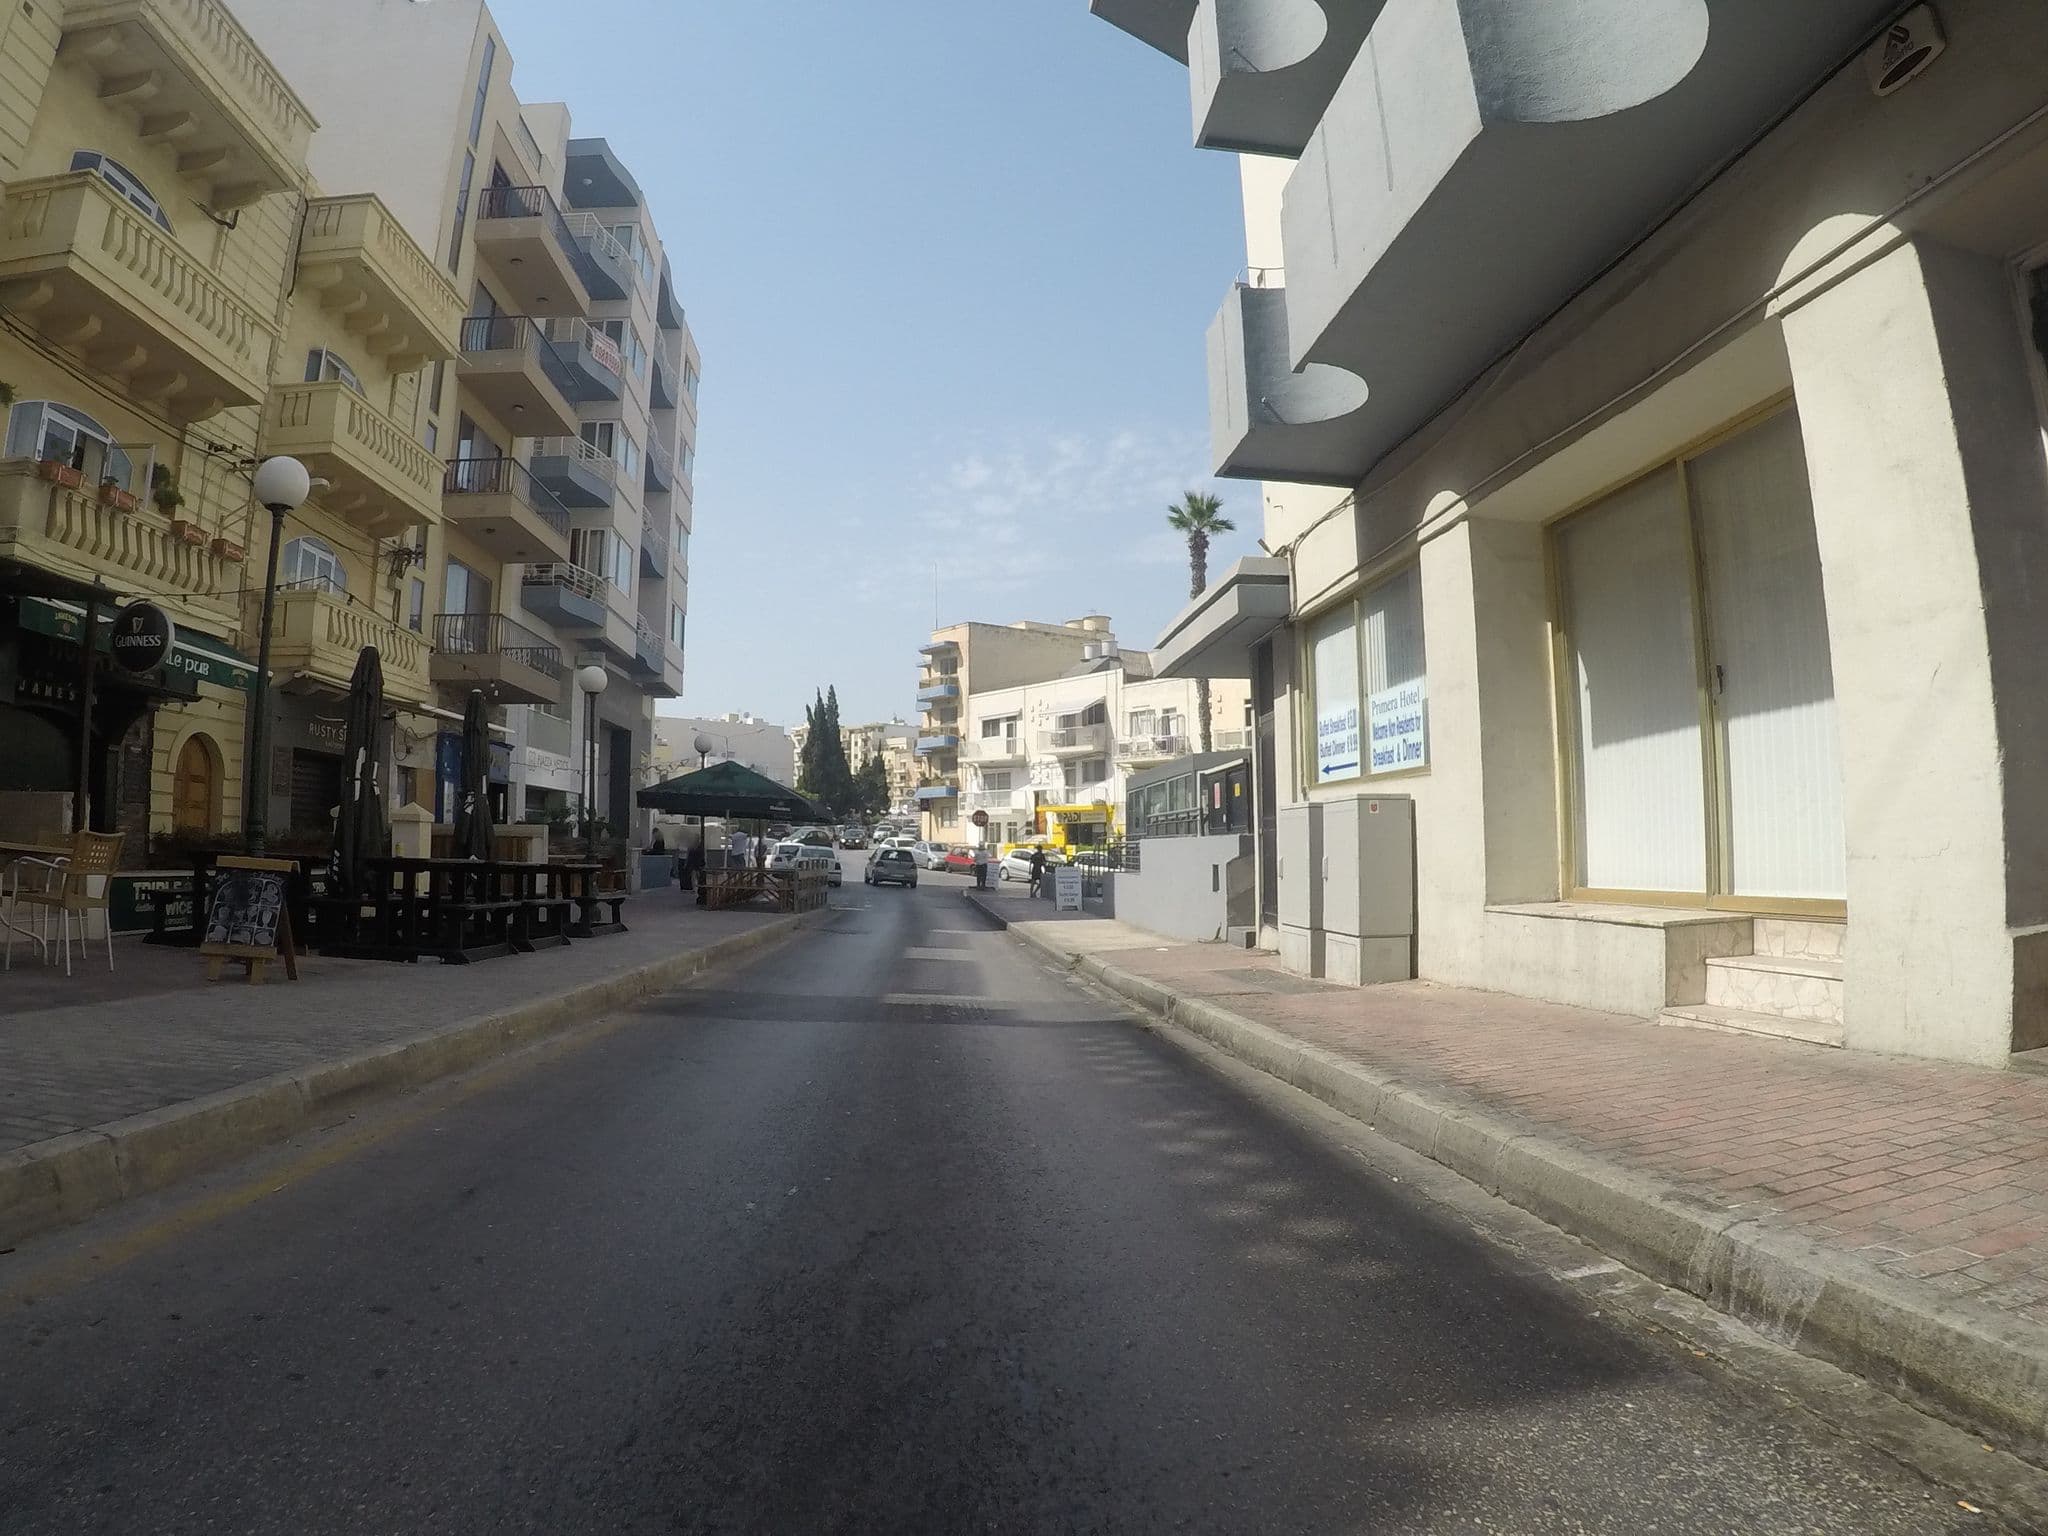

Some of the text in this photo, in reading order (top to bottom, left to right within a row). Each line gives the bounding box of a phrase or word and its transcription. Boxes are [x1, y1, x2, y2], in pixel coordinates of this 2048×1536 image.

[115, 634, 161, 648] GUINNESS
[1400, 687, 1421, 708] Hotel
[309, 722, 336, 742] RUSTY
[1402, 738, 1422, 761] Dinner
[1063, 811, 1081, 822] PADI
